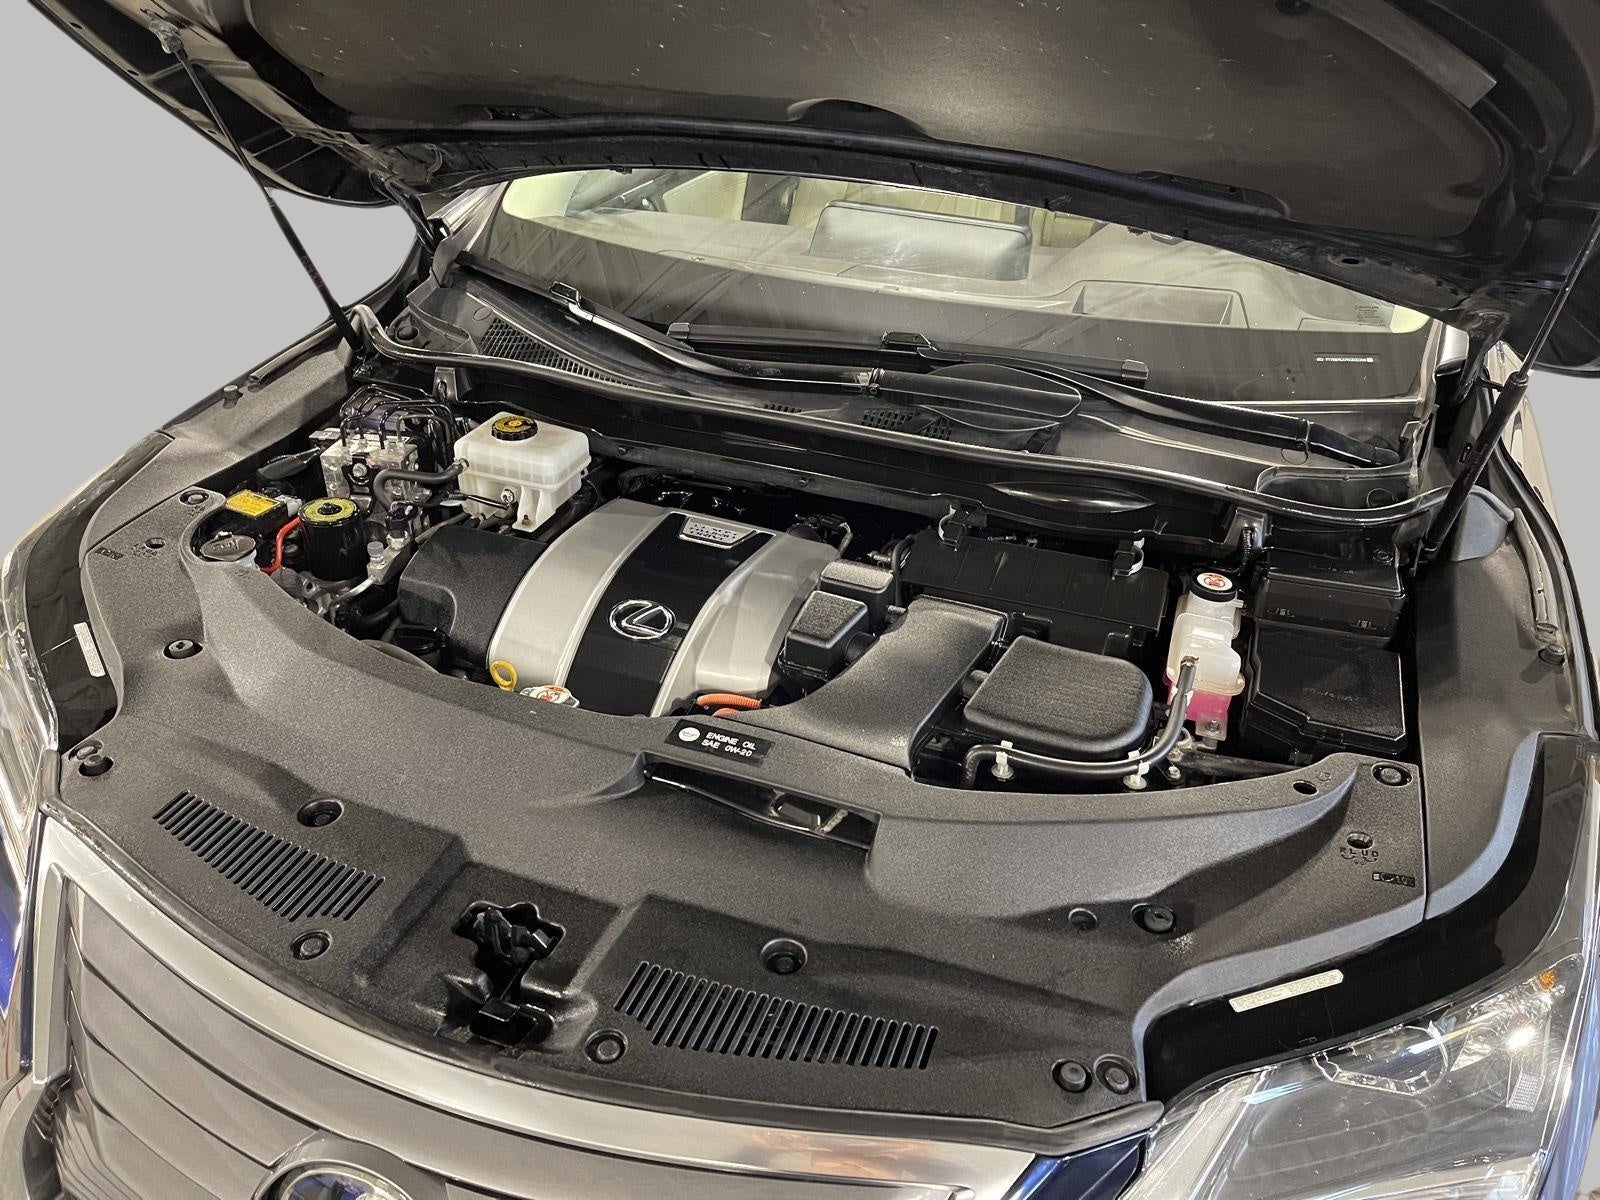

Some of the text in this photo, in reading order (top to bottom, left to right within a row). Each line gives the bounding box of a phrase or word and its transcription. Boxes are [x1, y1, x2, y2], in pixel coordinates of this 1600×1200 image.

[701, 739, 752, 756] SAE 0W-20
[706, 732, 756, 750] ENGINE OIL
